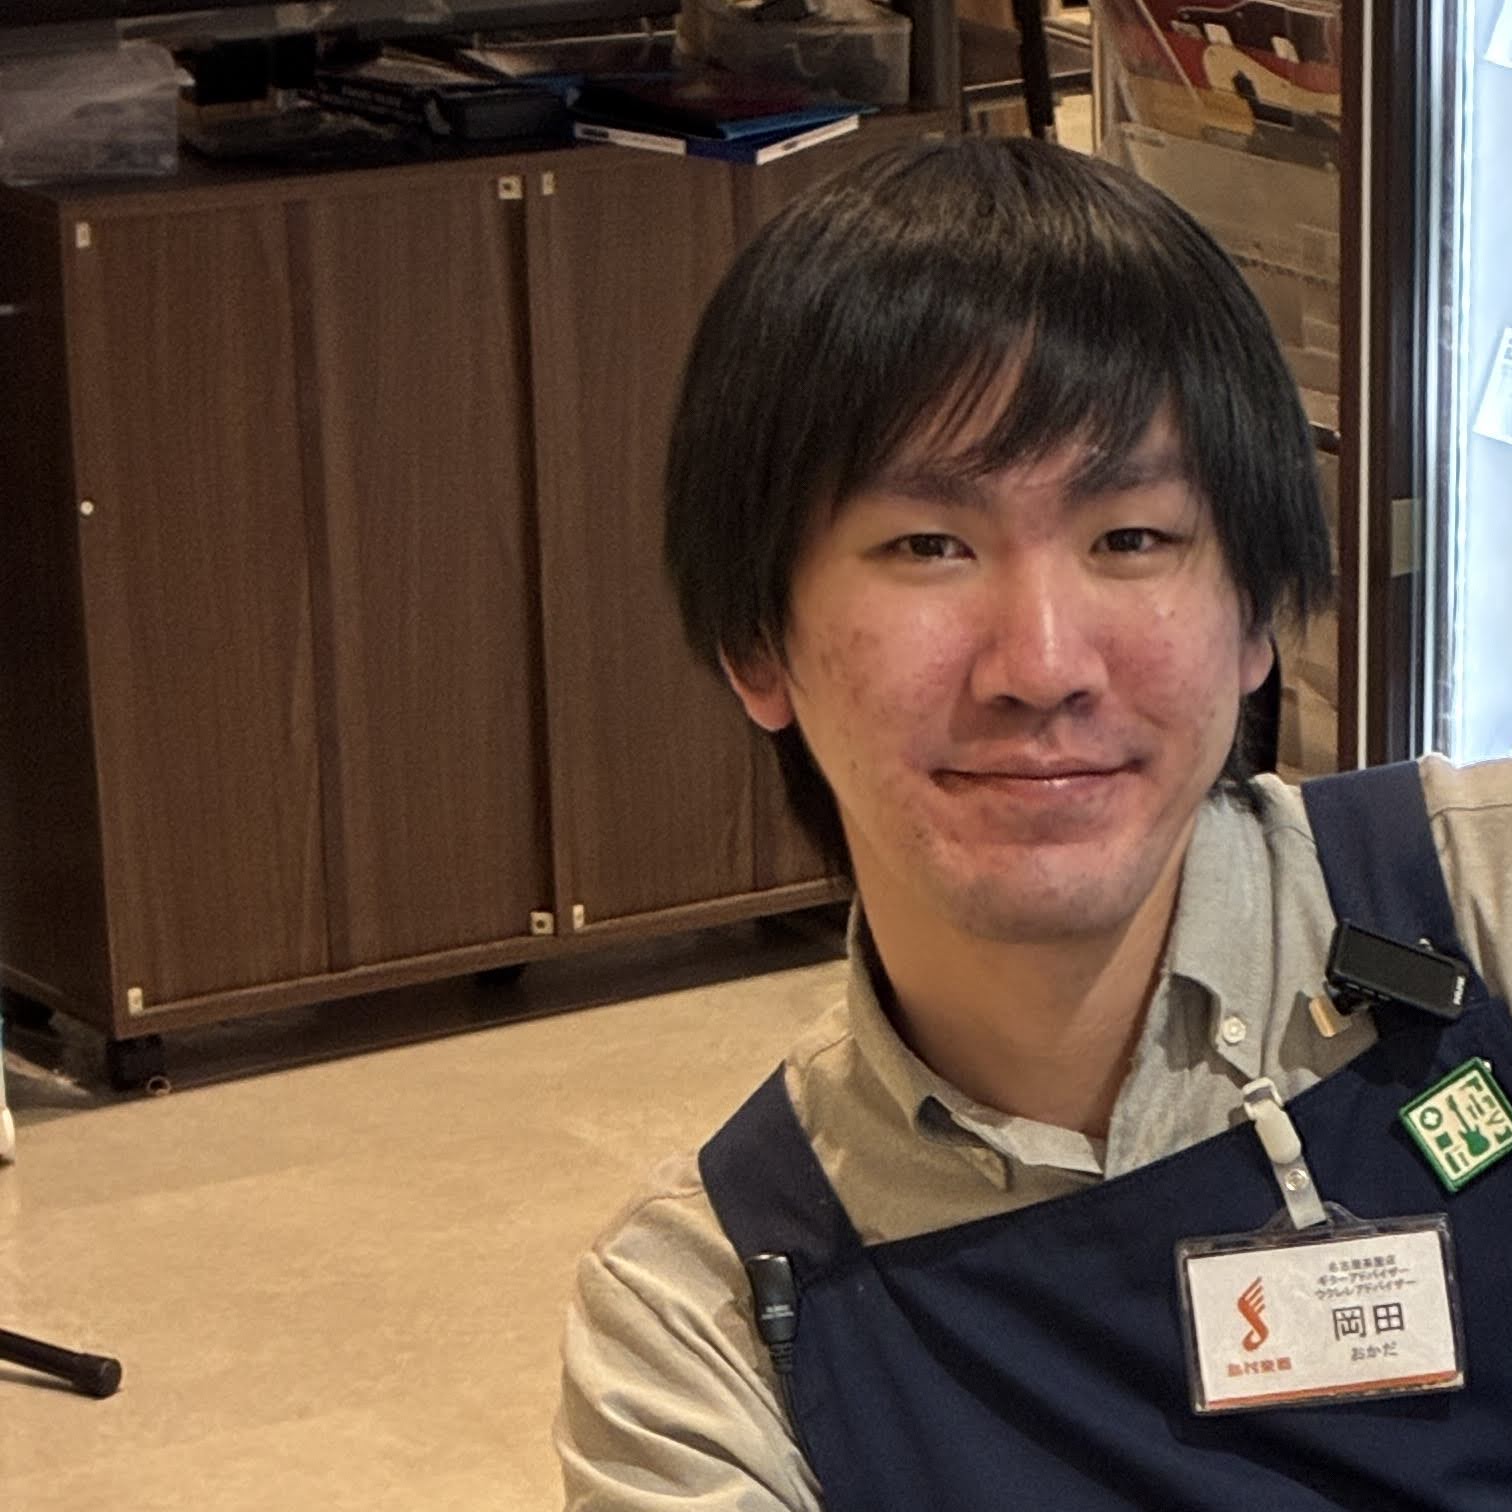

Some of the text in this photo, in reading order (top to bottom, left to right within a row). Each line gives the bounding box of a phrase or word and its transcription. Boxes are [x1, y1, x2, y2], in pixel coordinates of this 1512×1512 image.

[1331, 1302, 1405, 1341] 岡田
[1350, 1340, 1399, 1361] おかだ
